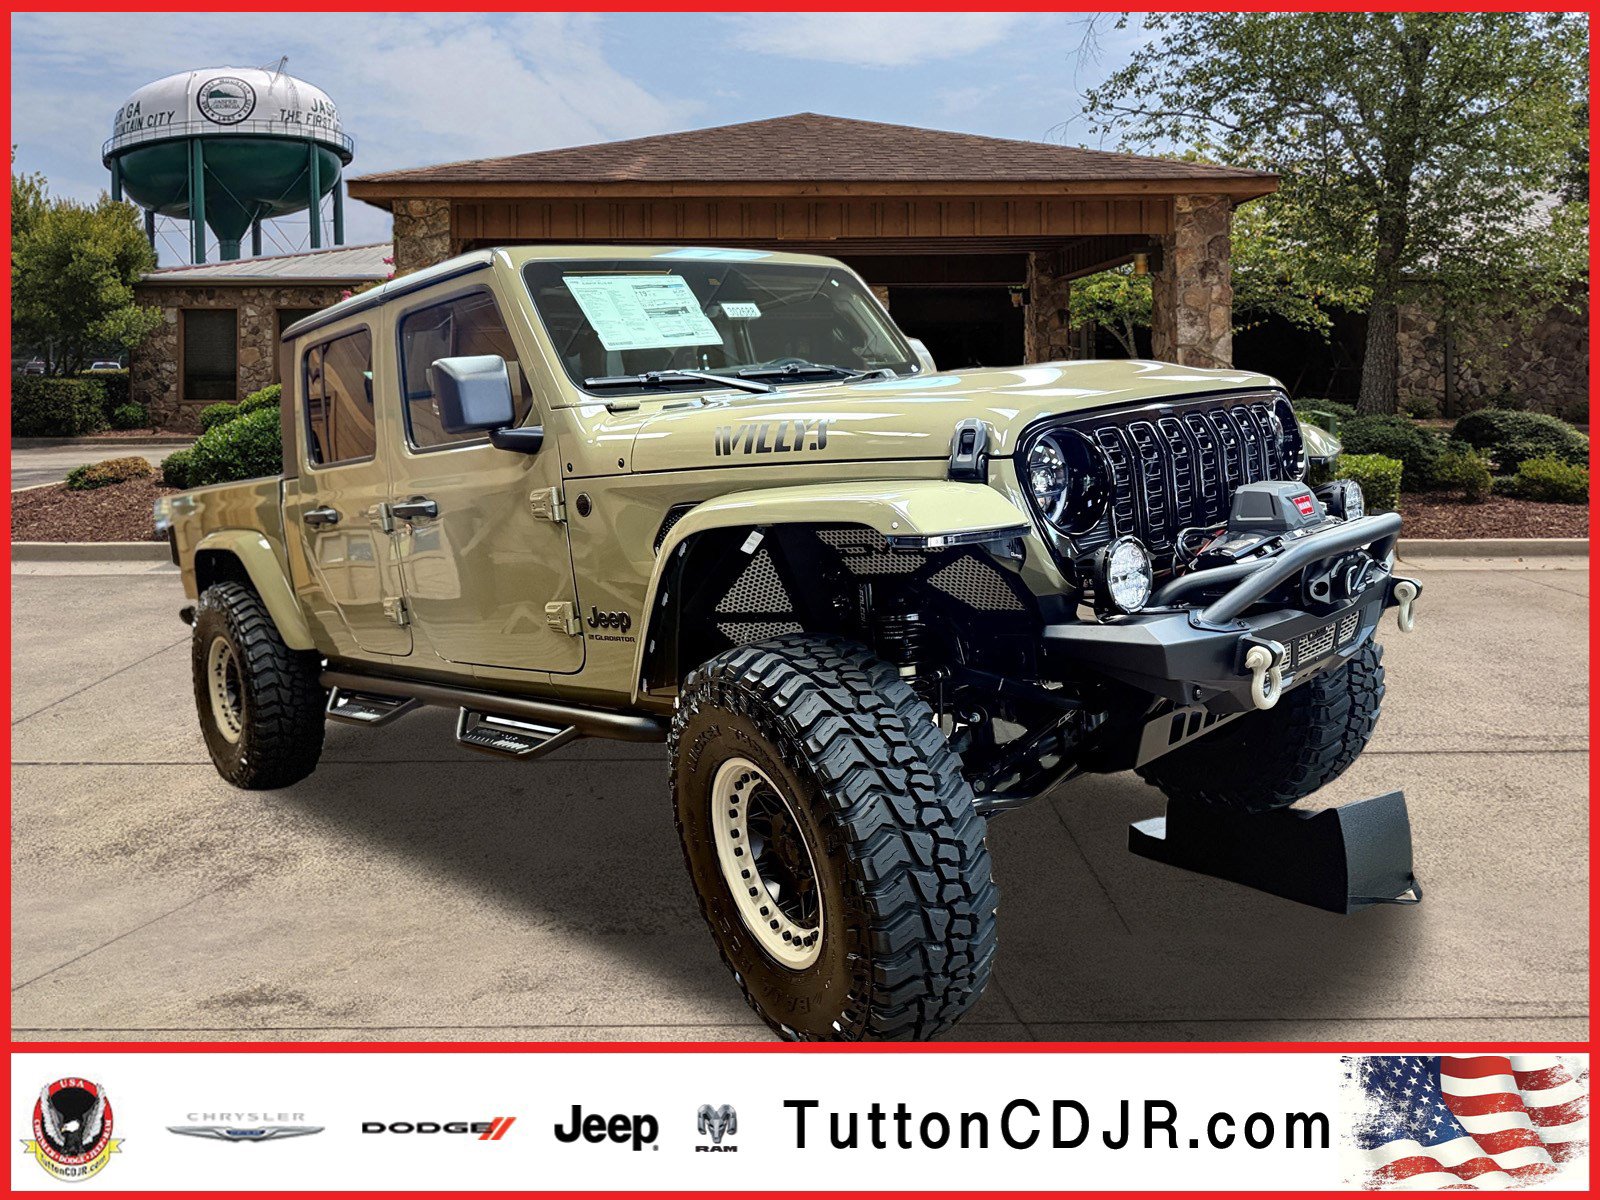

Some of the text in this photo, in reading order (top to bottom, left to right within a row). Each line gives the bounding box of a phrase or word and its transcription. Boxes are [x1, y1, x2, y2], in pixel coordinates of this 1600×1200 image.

[126, 100, 141, 118] GA
[280, 108, 302, 123] THE
[306, 112, 332, 128] FIRST
[147, 110, 176, 127] CITY
[587, 605, 632, 633] Jeep
[595, 634, 636, 643] GLADIATOR
